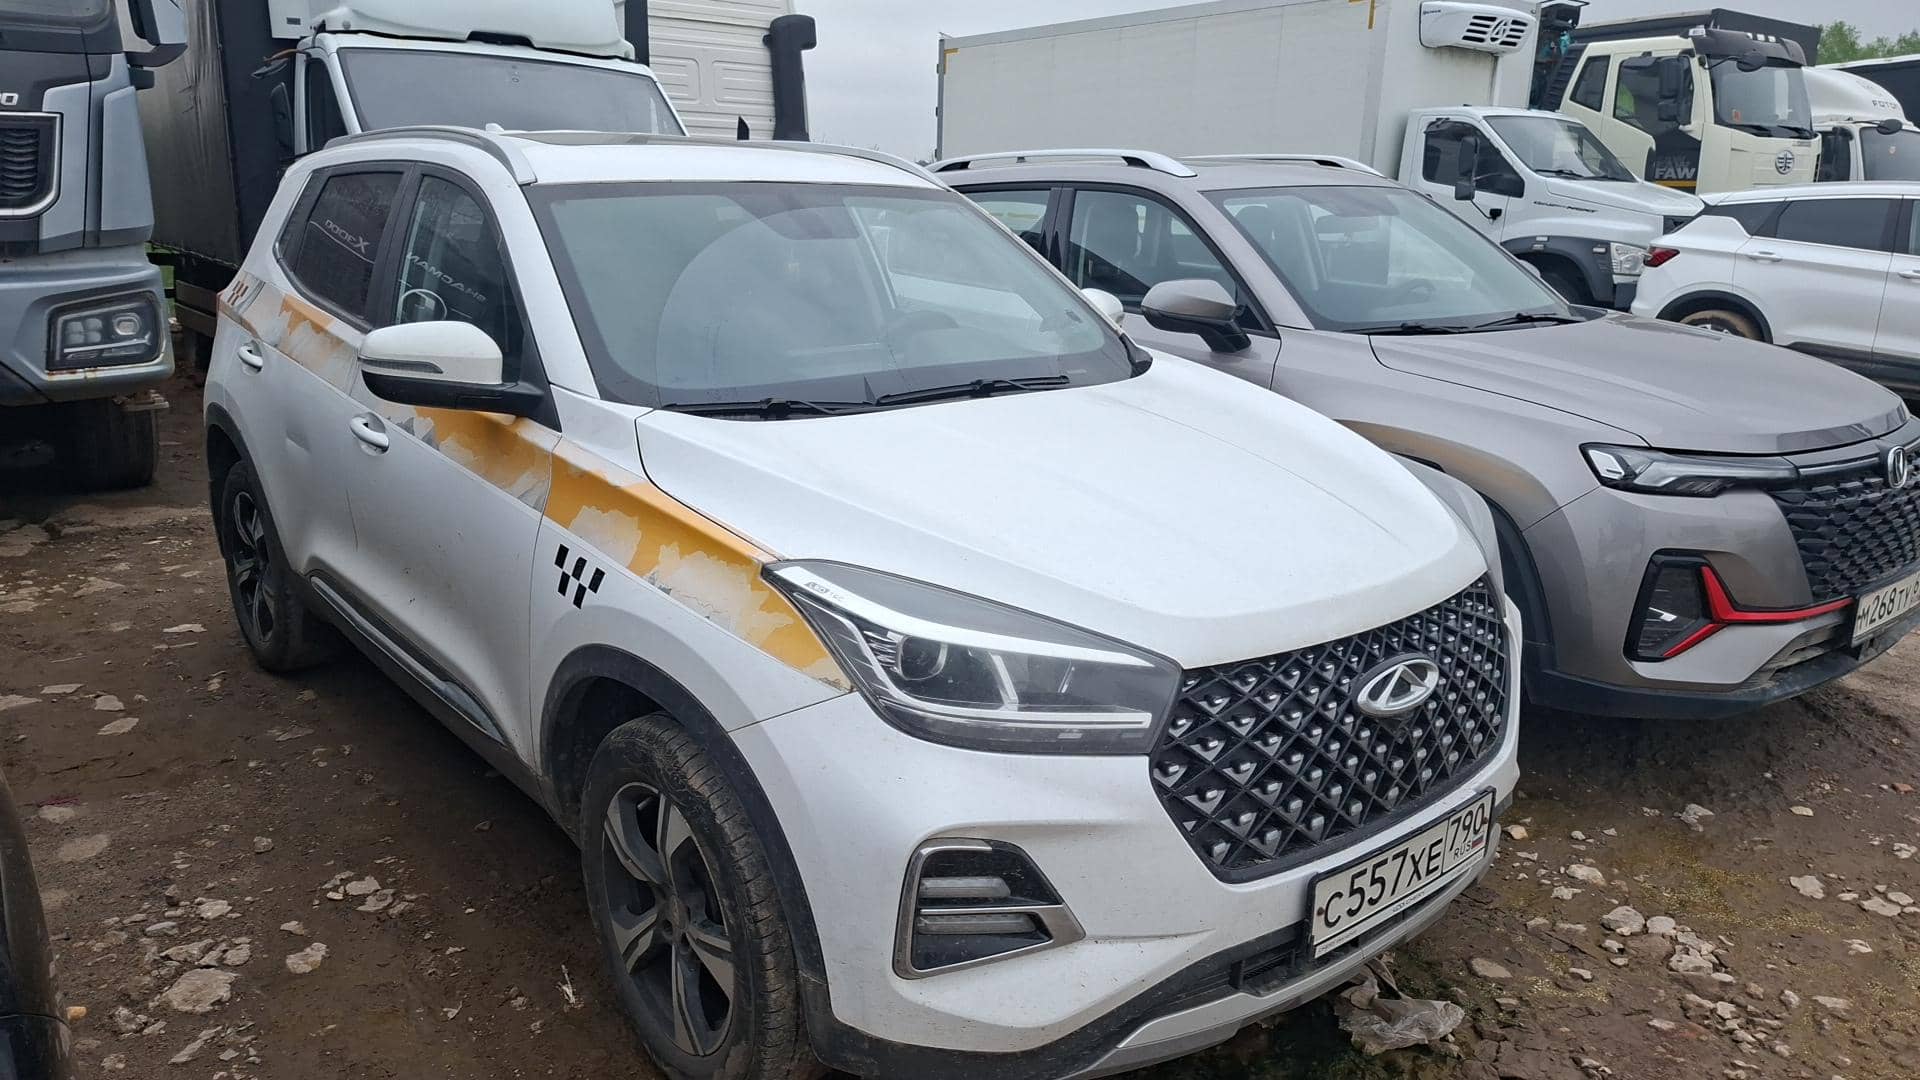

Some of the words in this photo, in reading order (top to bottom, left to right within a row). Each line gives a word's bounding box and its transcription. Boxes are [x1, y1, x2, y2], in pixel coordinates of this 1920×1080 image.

[1654, 167, 1696, 180] FAW
[1449, 802, 1485, 853] 790
[1453, 840, 1472, 860] RUS
